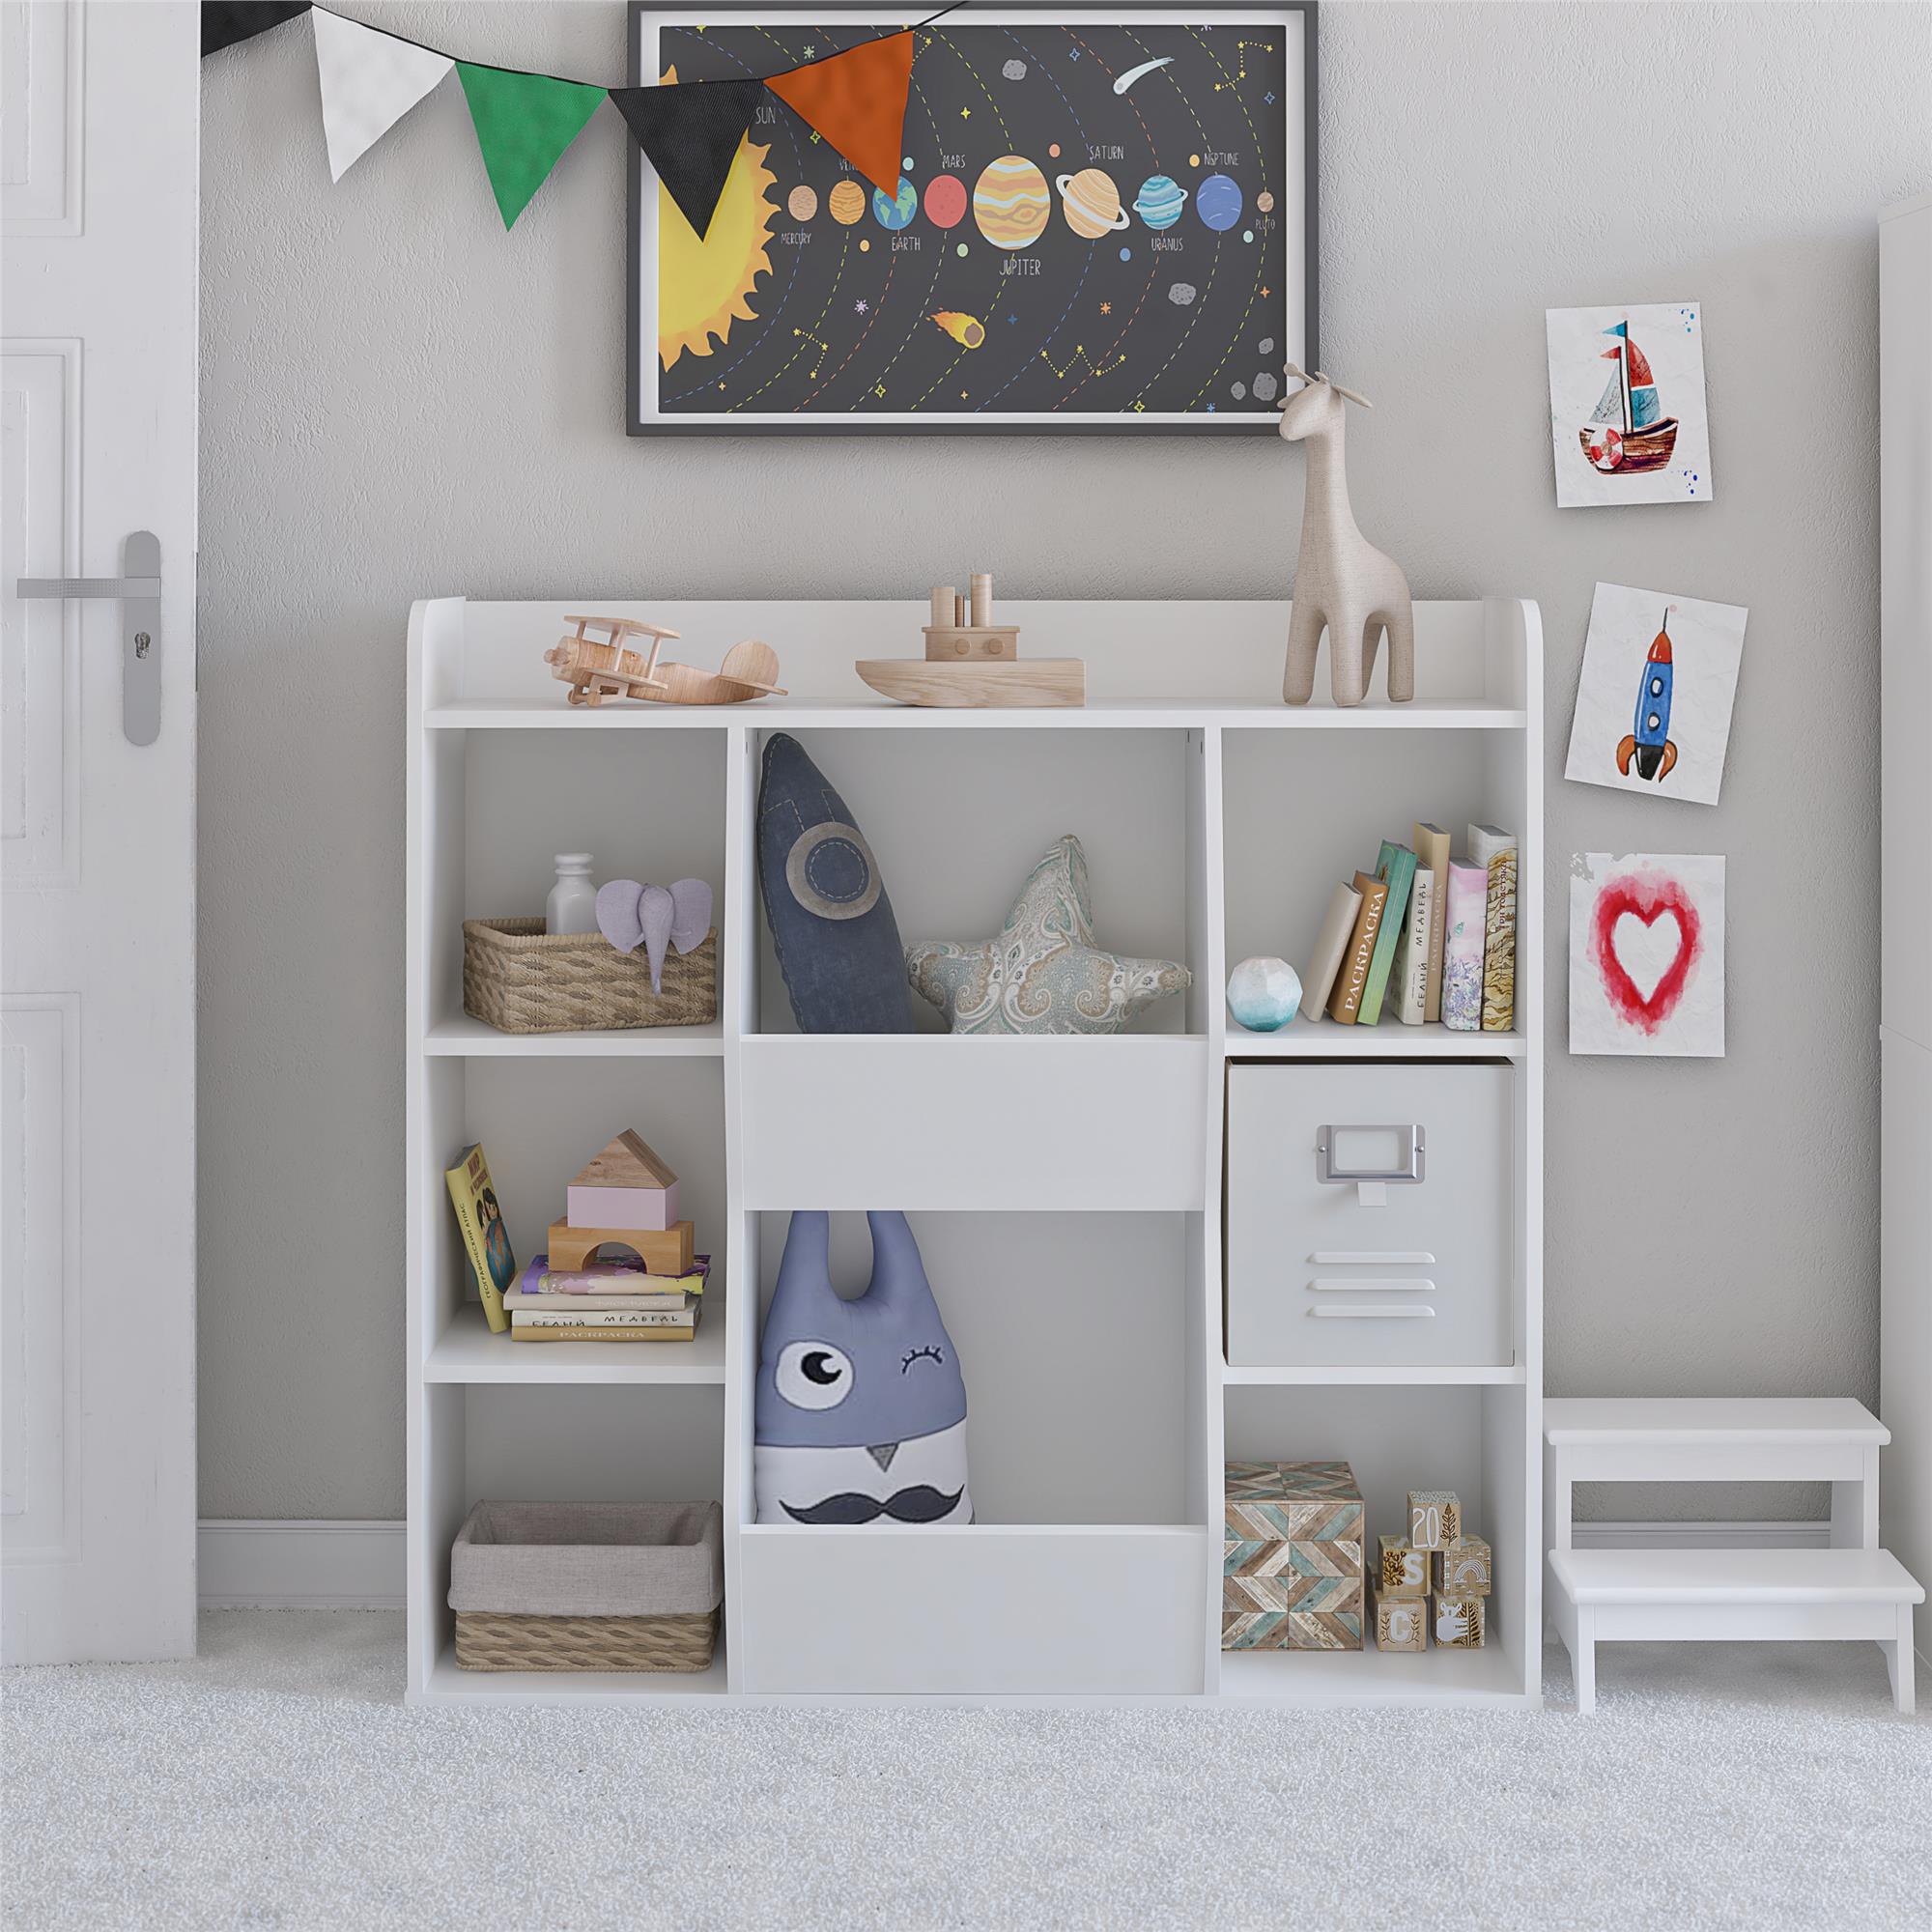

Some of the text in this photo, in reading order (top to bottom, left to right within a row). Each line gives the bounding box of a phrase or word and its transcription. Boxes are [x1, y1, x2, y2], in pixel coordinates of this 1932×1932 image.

[755, 106, 776, 125] SUN
[942, 155, 966, 169] MARS
[1090, 146, 1123, 161] SATURN
[1204, 153, 1238, 166] NEPTUNE
[1256, 218, 1276, 230] PLUTO
[781, 232, 811, 245] MERCURY
[892, 237, 921, 251] EARTH
[1151, 238, 1183, 252] URANUS
[999, 259, 1041, 276] JUPITER
[1416, 882, 1427, 947] МЕДВЕДЬ
[1345, 892, 1384, 1010] РАСКРАСКА
[461, 1202, 471, 1229] АТЛАС
[1412, 1506, 1440, 1548] 20
[1403, 1553, 1425, 1585] S
[1389, 1610, 1411, 1641] C
